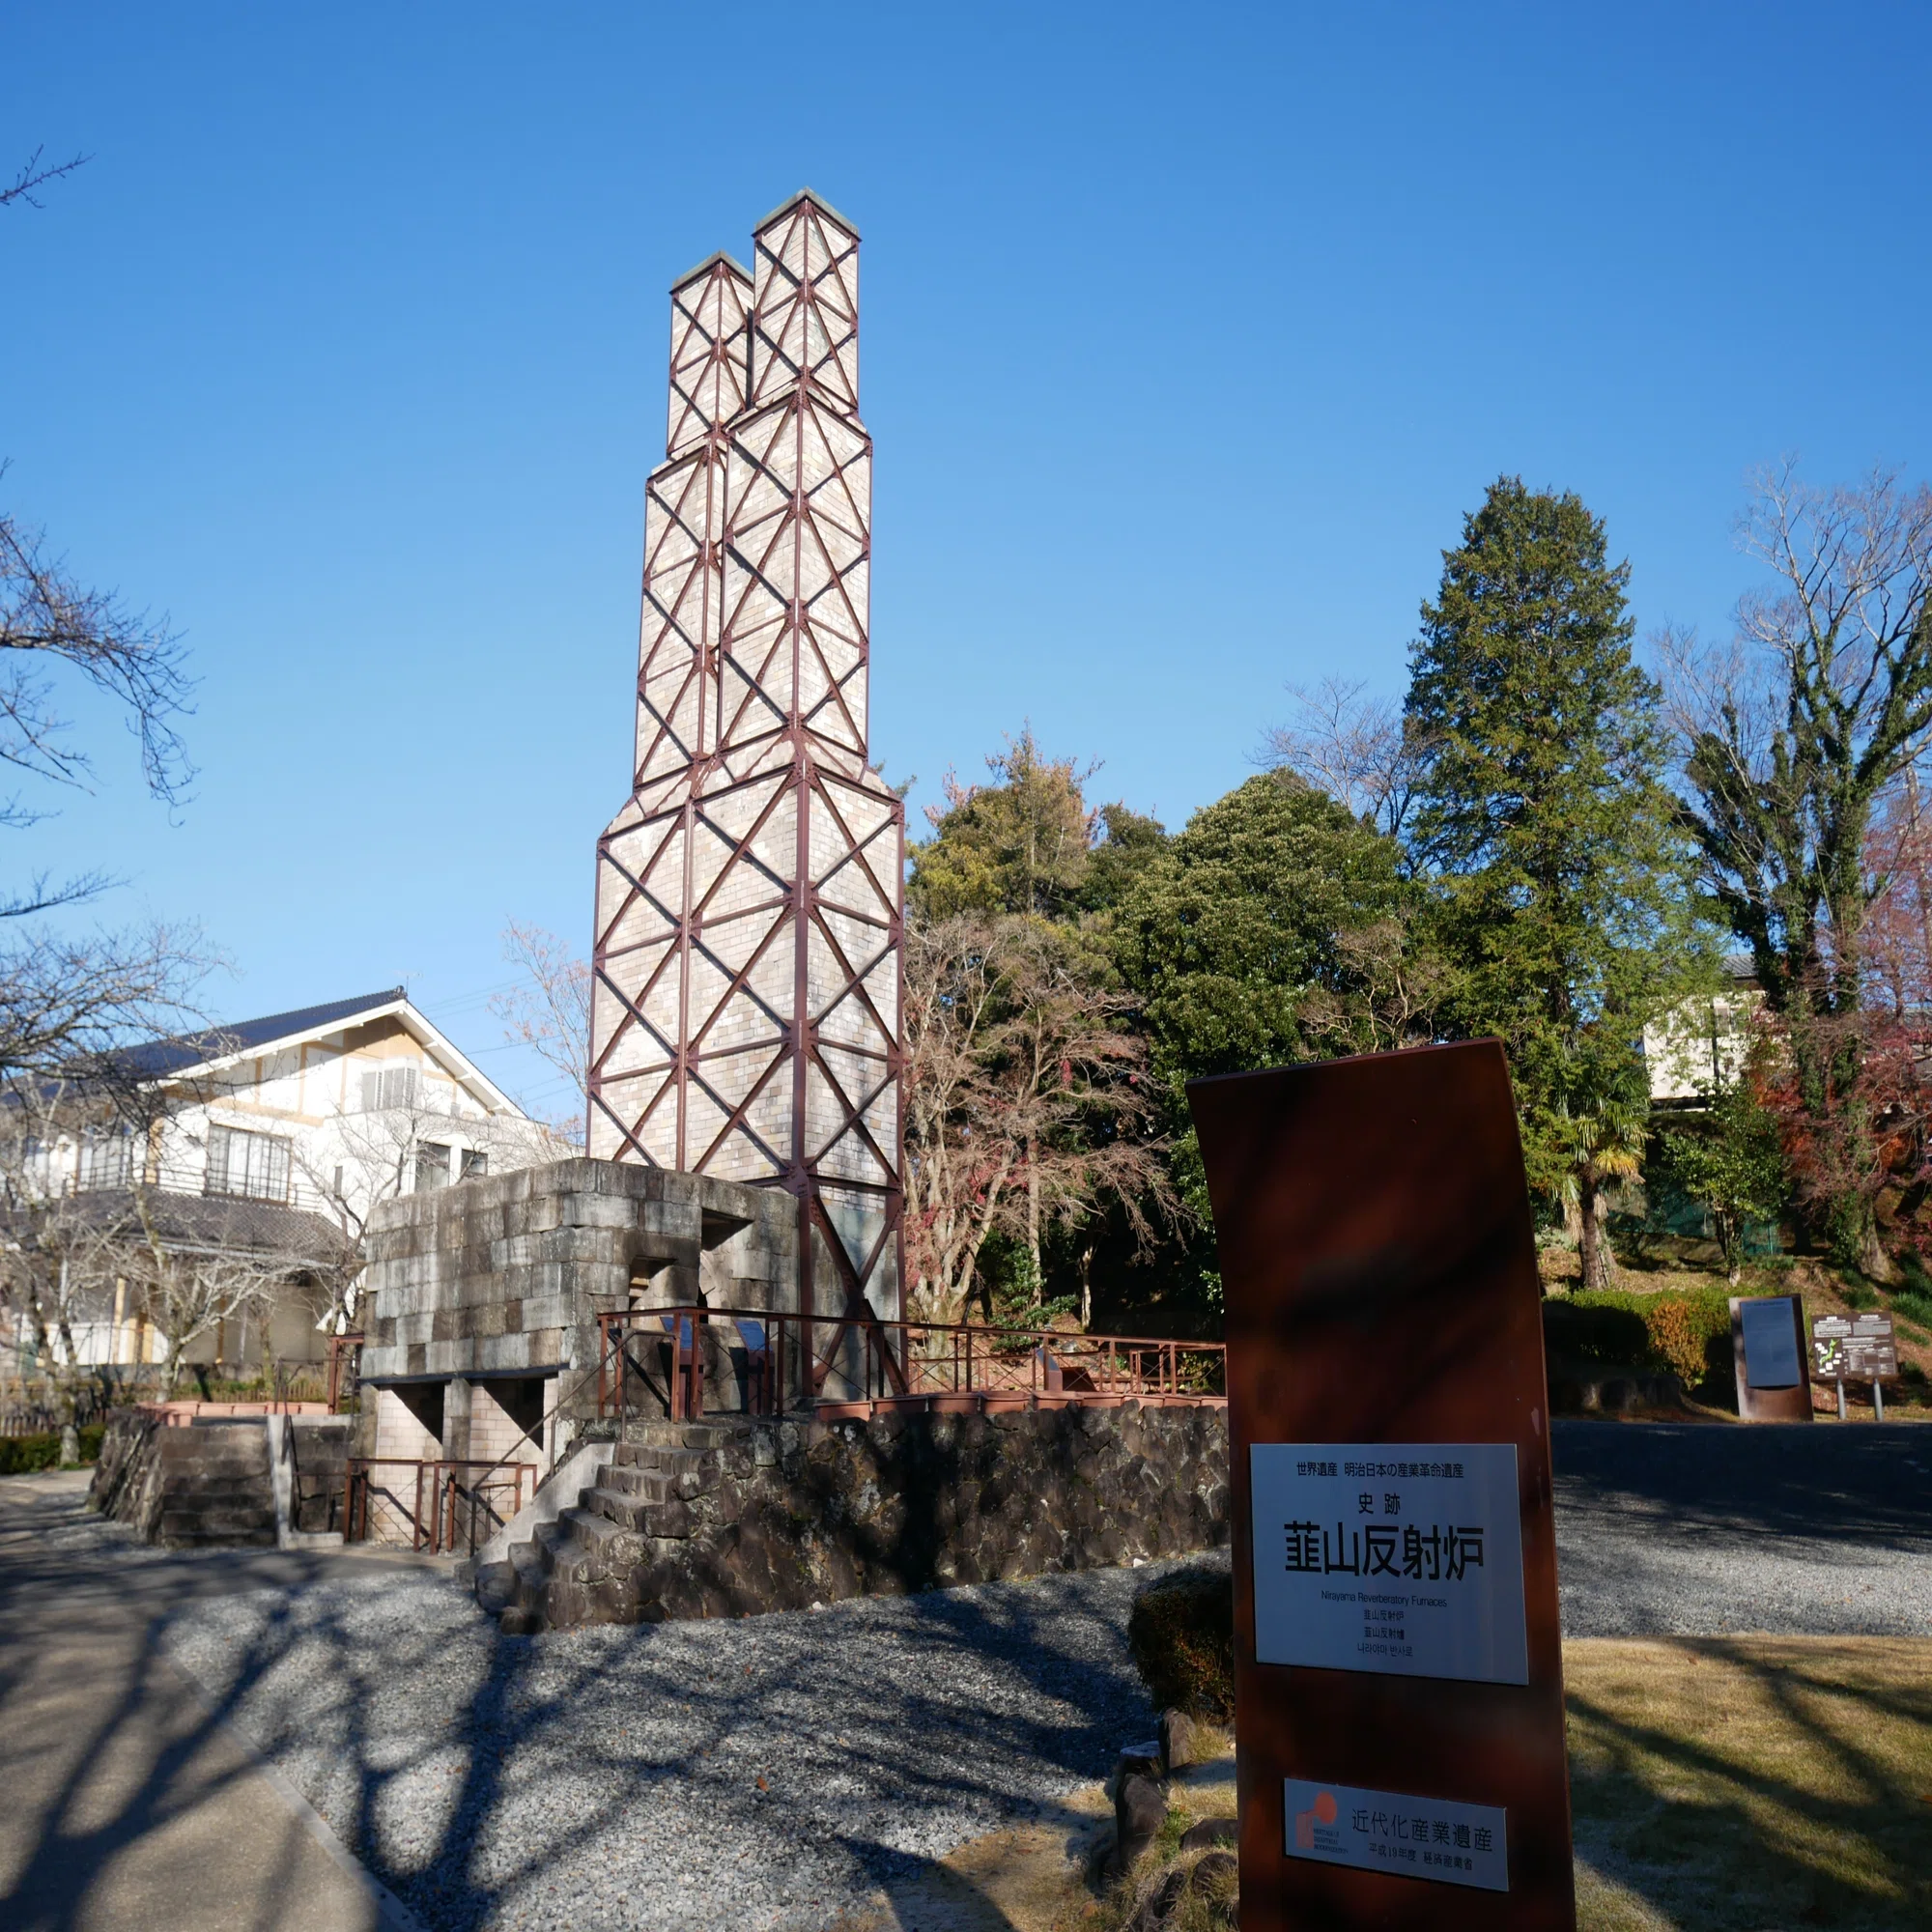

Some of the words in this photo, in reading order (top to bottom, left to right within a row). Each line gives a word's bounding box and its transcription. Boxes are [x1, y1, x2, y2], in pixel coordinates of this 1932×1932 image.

[1296, 1462, 1338, 1477] 世界遺産
[1344, 1463, 1464, 1478] 明治日本の産業革命遺産
[1284, 1520, 1484, 1581] 韮山反射炉
[1321, 1590, 1356, 1603] Nirayama
[1357, 1592, 1409, 1606] Reverberatory
[1411, 1595, 1447, 1607] Furnaces
[1357, 1643, 1388, 1656] 니라야마
[1389, 1645, 1413, 1657] 반사로
[1352, 1808, 1492, 1852] 近代化産業遺産
[1369, 1842, 1416, 1861] 平成19年度
[1423, 1851, 1473, 1870] 経済産業省
